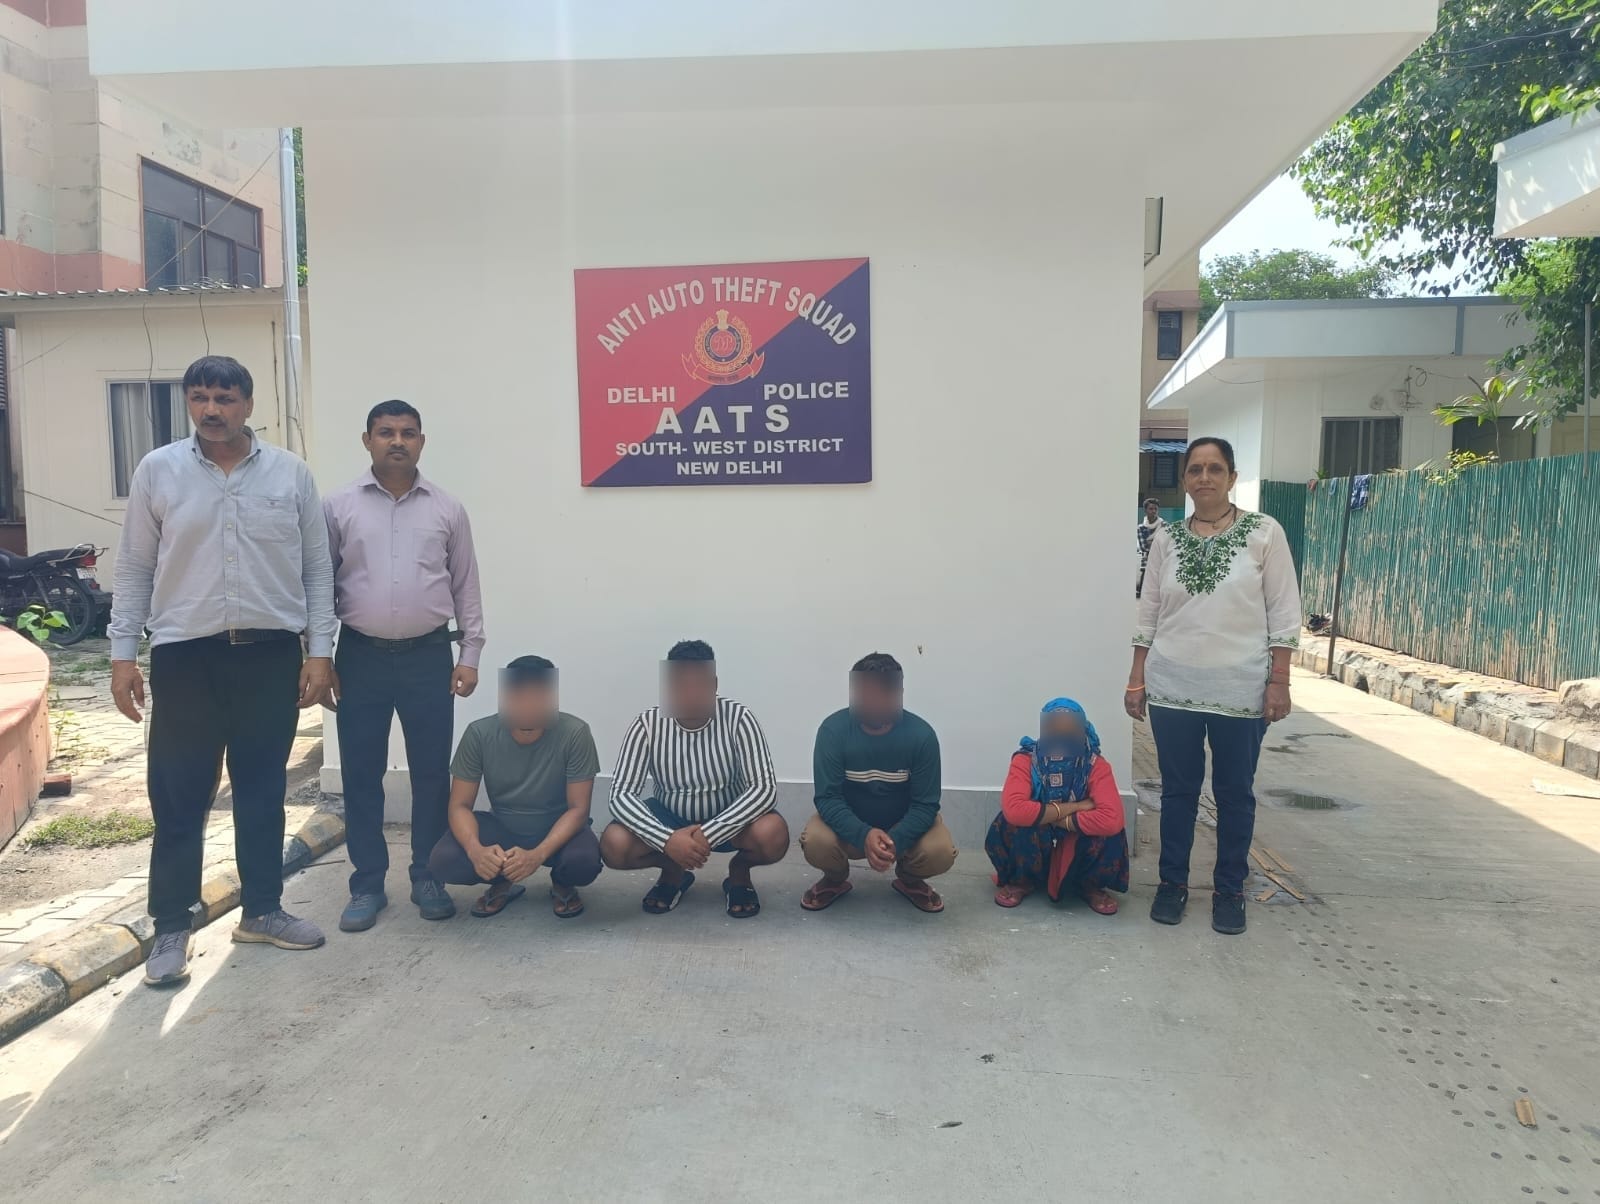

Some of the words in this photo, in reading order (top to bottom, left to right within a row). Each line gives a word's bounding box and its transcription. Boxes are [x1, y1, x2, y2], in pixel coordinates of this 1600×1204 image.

[597, 303, 646, 354] ANTI
[647, 279, 705, 319] AUTO
[711, 276, 782, 306] THEFT
[784, 286, 857, 345] SQUAD
[607, 386, 675, 403] DELHI
[763, 381, 849, 400] POLICE
[693, 440, 747, 455] WEST
[753, 438, 844, 454] DISTRICT
[676, 461, 719, 475] NEW
[725, 460, 782, 475] DELHI
